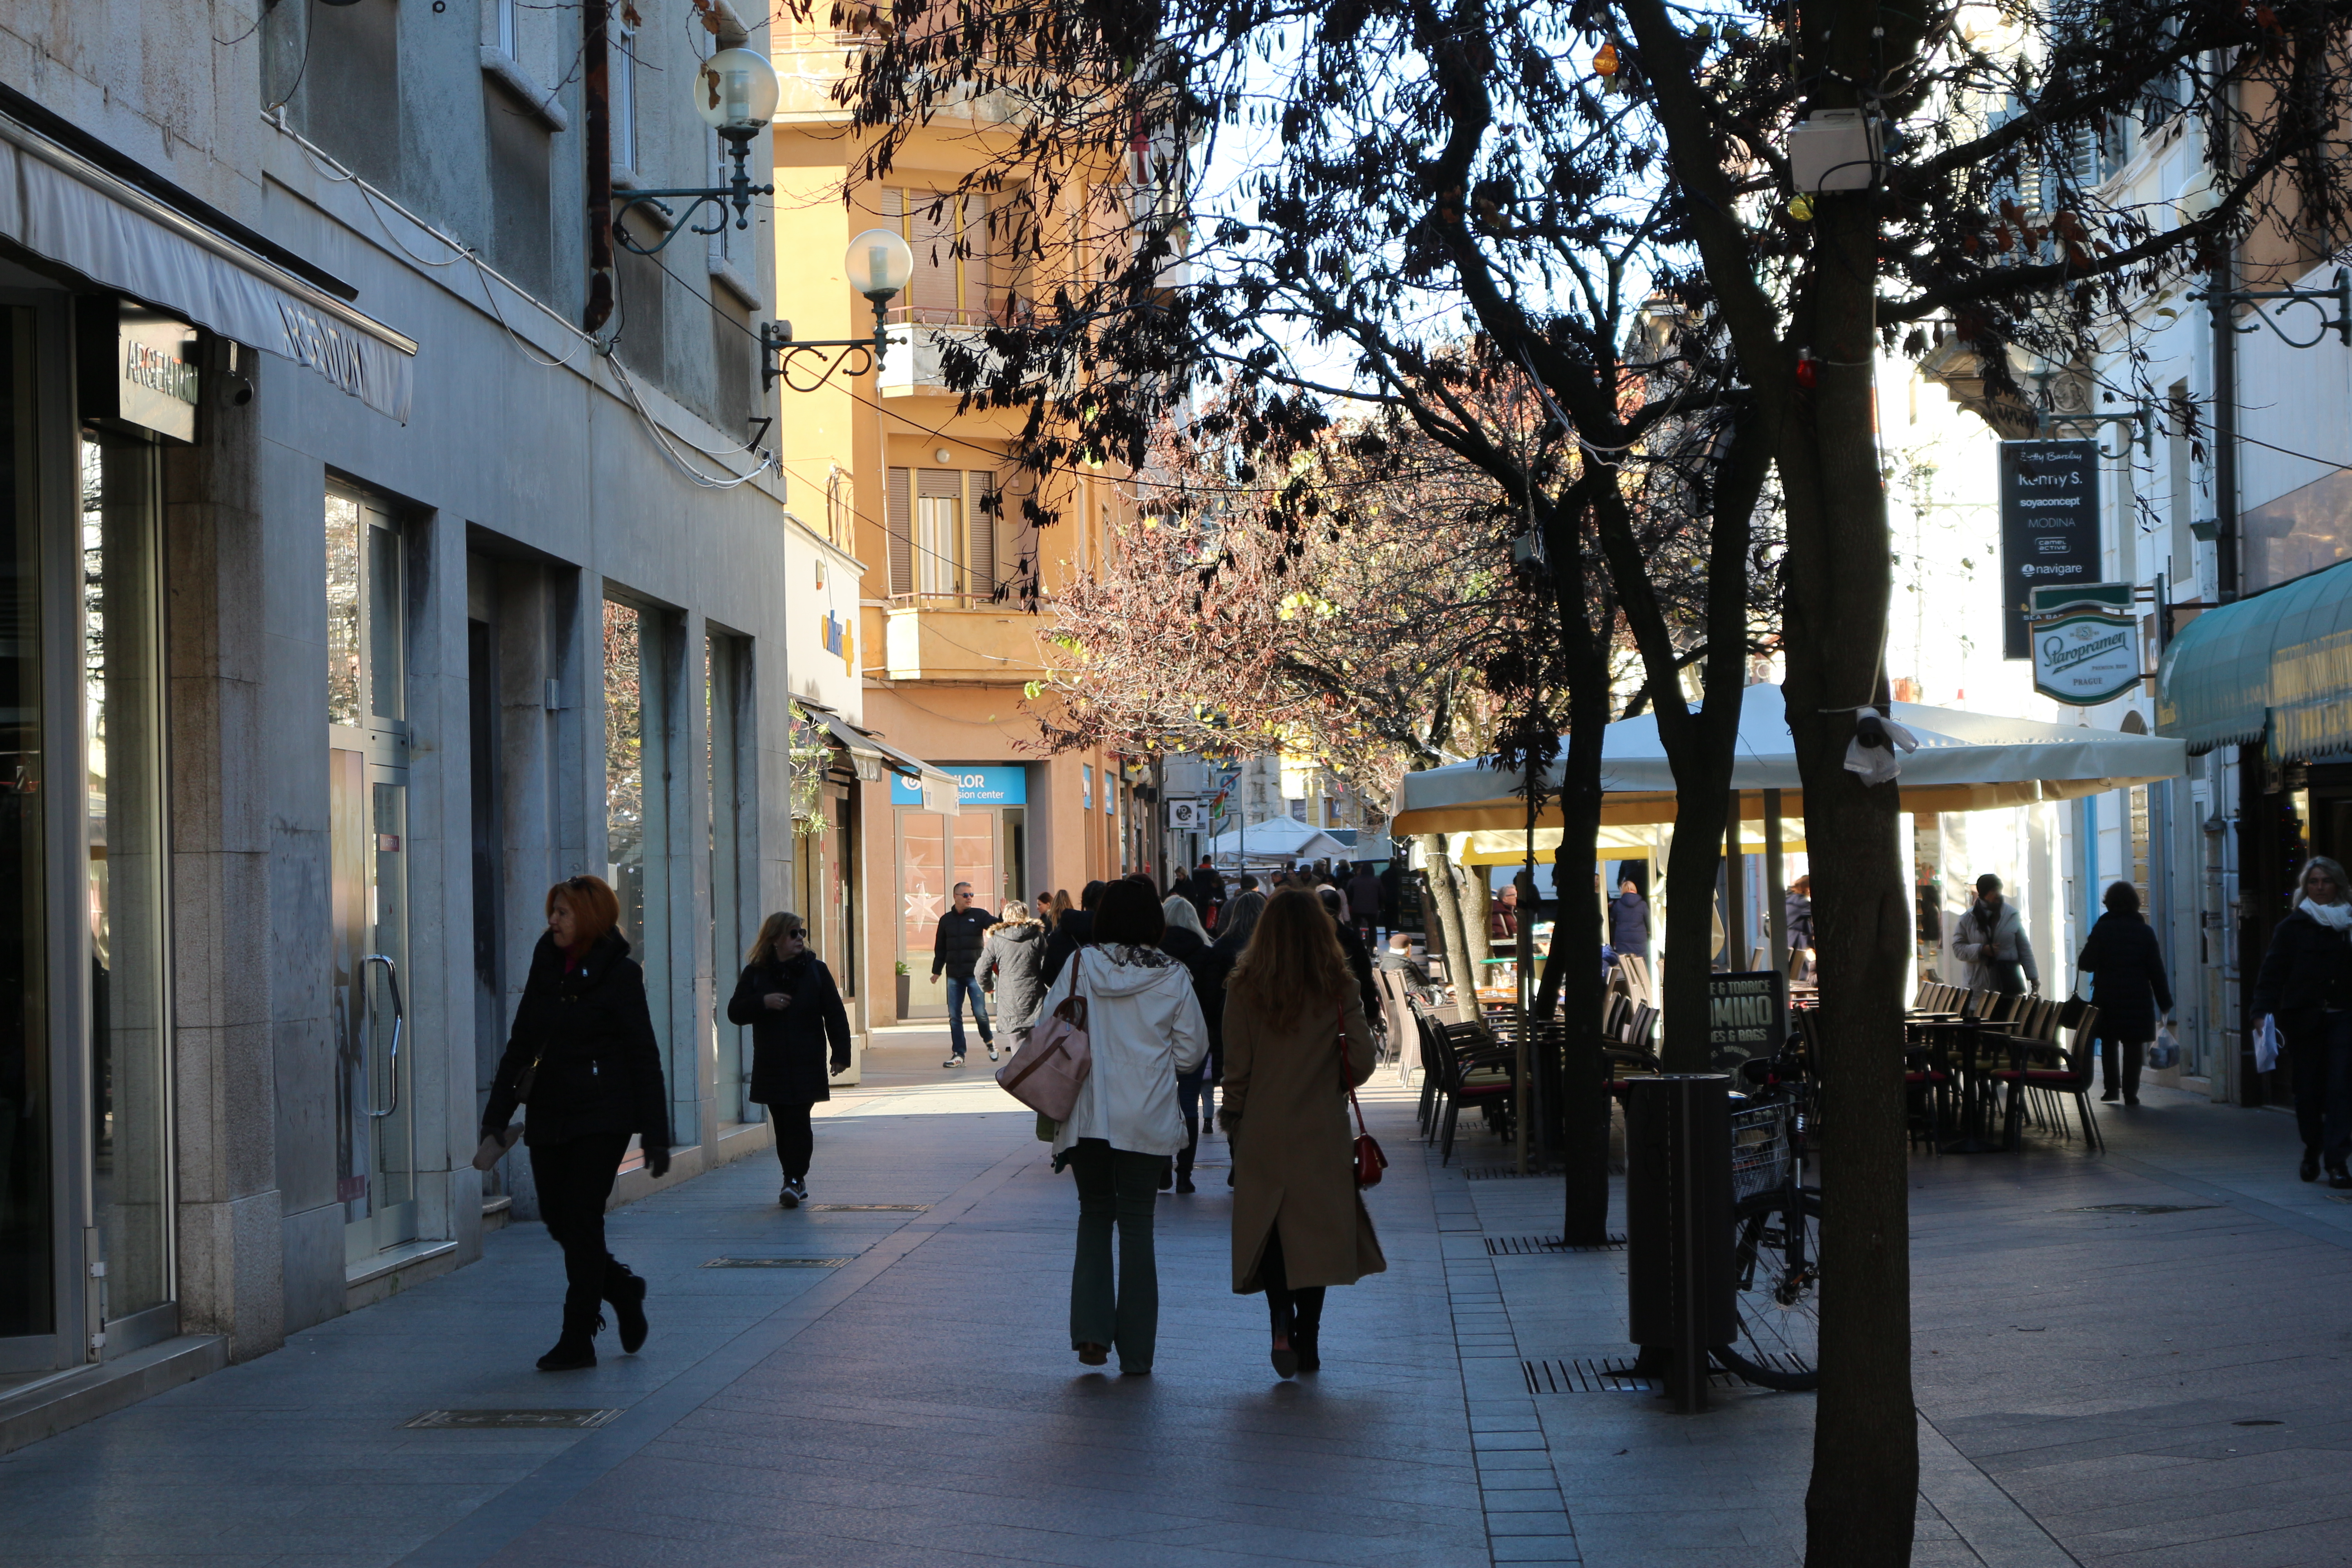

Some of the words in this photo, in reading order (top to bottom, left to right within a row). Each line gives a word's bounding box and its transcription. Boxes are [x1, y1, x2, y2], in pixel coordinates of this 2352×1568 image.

[277, 301, 364, 392] ARGENTUM
[126, 339, 198, 405] ARGENTUM
[2046, 451, 2082, 462] Barclay
[2071, 471, 2082, 484] S.
[2020, 497, 2080, 509] soyaconcept
[2029, 518, 2076, 528] MODINA
[2037, 563, 2082, 576] navigare
[2043, 632, 2128, 669] Staropramen
[2073, 677, 2103, 686] PRAGUE
[977, 790, 1004, 799] center
[1728, 980, 1771, 995] TORBICE
[1710, 995, 1773, 1028] MINO
[1738, 1028, 1767, 1042] BAGS
